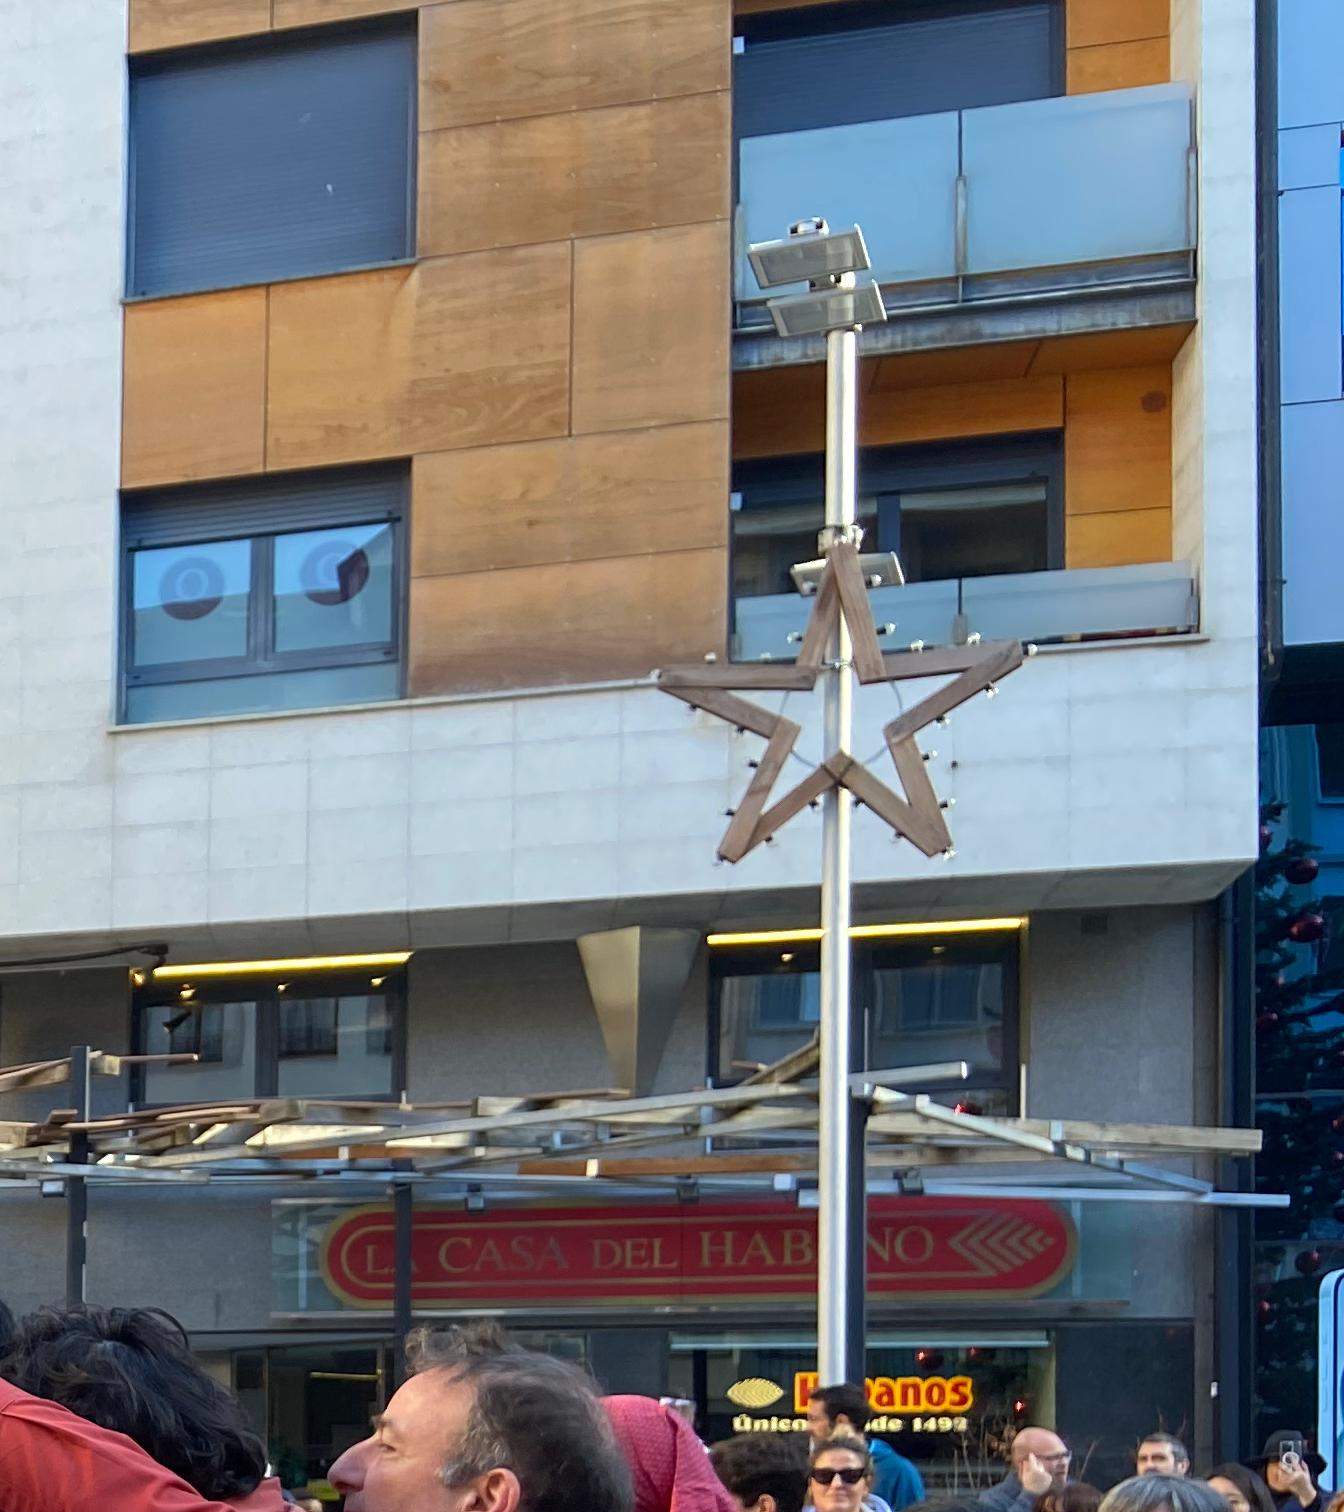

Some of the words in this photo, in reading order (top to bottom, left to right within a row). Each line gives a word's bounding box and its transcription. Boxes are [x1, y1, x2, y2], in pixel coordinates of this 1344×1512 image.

[438, 1235, 571, 1274] CASA
[591, 1237, 679, 1270] DEL
[699, 1225, 935, 1268] HABNO
